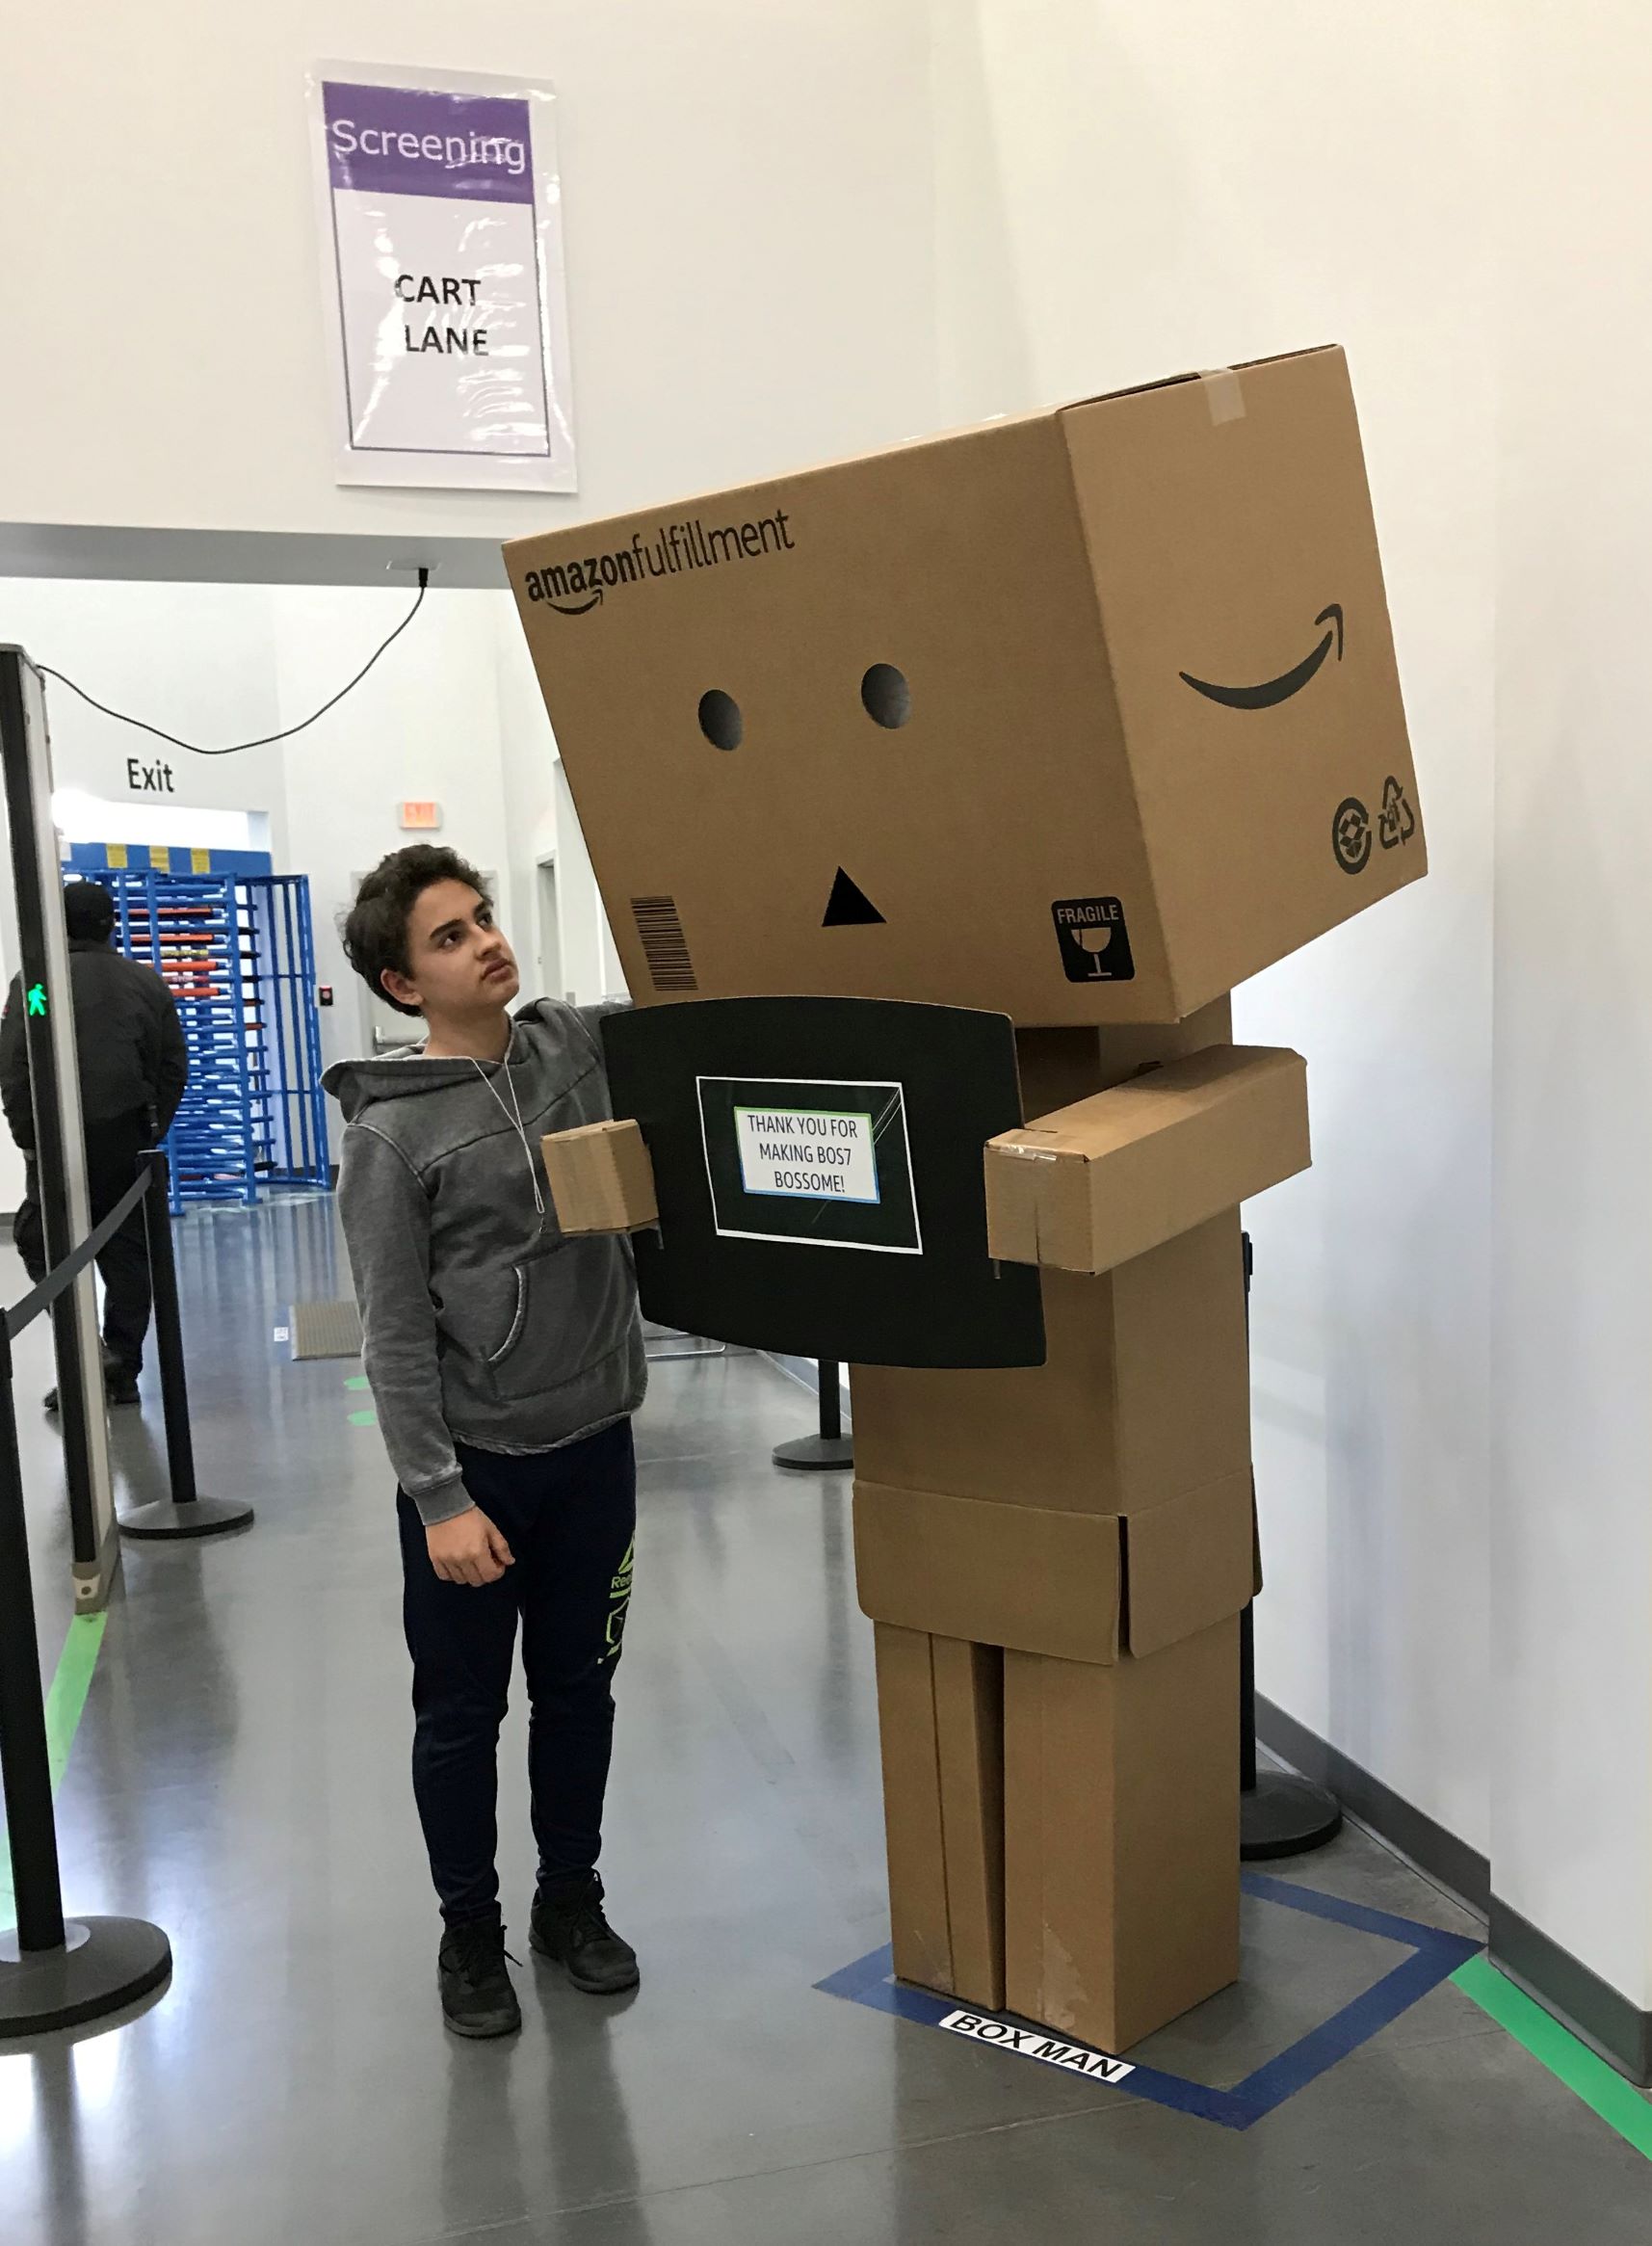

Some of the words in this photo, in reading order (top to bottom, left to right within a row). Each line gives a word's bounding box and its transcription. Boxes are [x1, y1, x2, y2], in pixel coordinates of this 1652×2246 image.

[331, 119, 526, 175] Screening
[394, 274, 482, 306] CART
[404, 325, 489, 357] LANE
[127, 757, 175, 793] Exit
[1057, 904, 1119, 925] FRAGILE
[747, 1115, 795, 1134] THANK
[797, 1117, 826, 1136] YOU
[830, 1119, 858, 1139] FOR
[759, 1143, 814, 1163] MAKING
[817, 1146, 852, 1166] BOS7
[774, 1171, 846, 1193] BOSSOME!
[950, 2014, 1036, 2049] BOX
[1033, 2040, 1123, 2078] MAN
